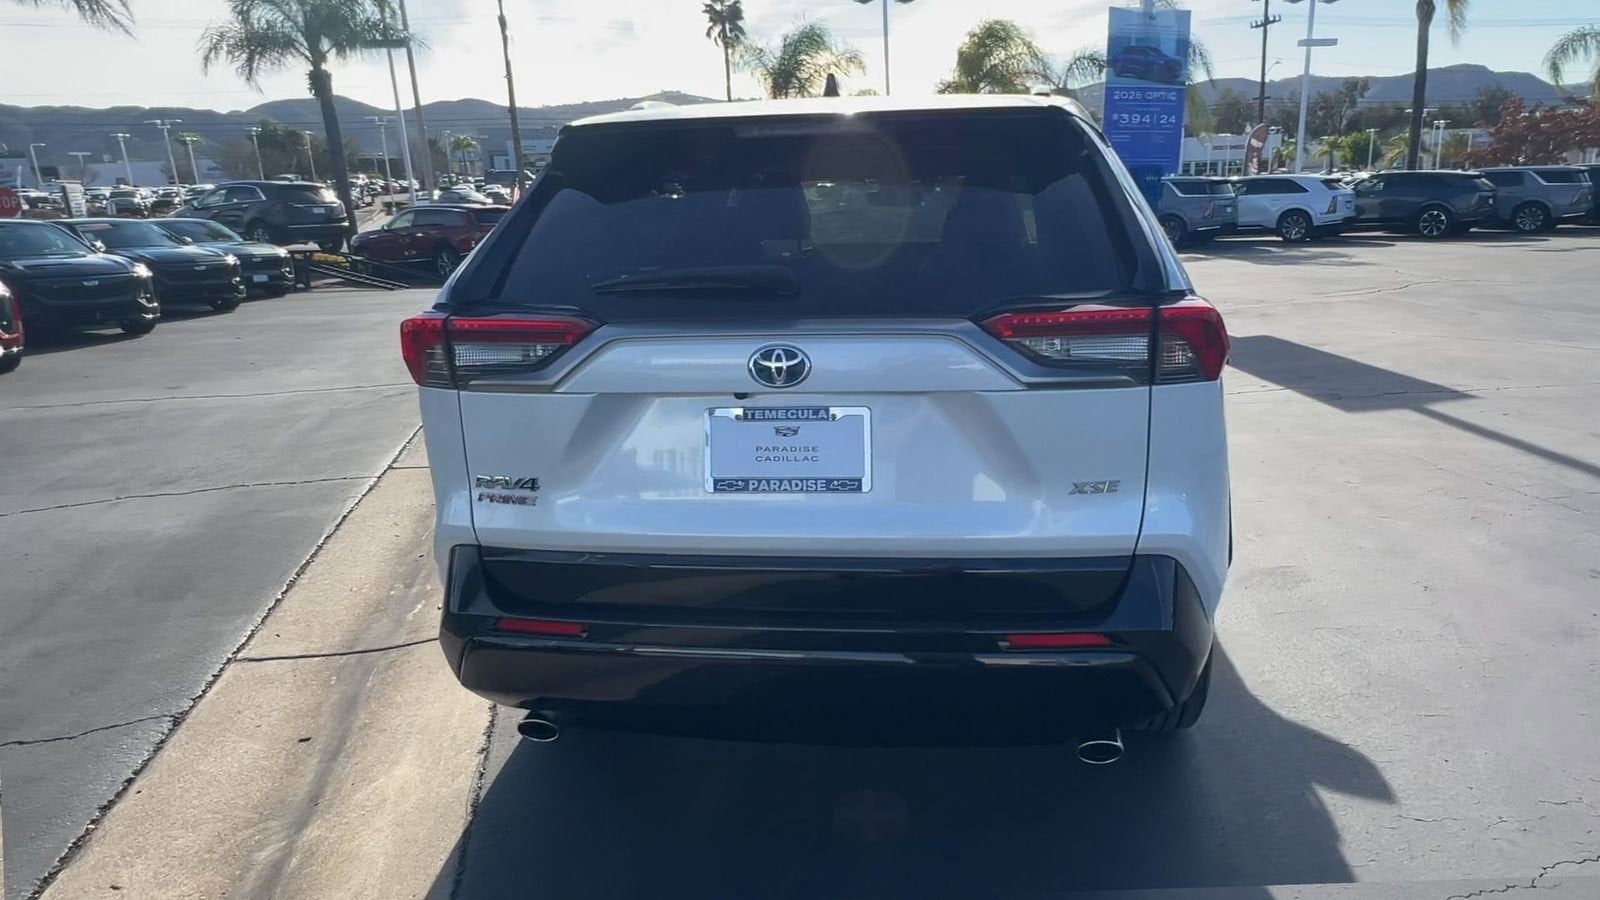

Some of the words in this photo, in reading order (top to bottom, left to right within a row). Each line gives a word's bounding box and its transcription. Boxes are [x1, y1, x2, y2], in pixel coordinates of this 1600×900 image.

[1145, 91, 1177, 101] OPTIC
[1159, 114, 1176, 124] 24
[745, 408, 828, 420] TEMECULA
[755, 445, 819, 453] PARADISE
[755, 455, 820, 463] CADILLAC
[475, 474, 540, 491] RAV4
[748, 479, 827, 491] PARADISE
[1067, 479, 1121, 495] XSE
[477, 493, 538, 506] PRIME
